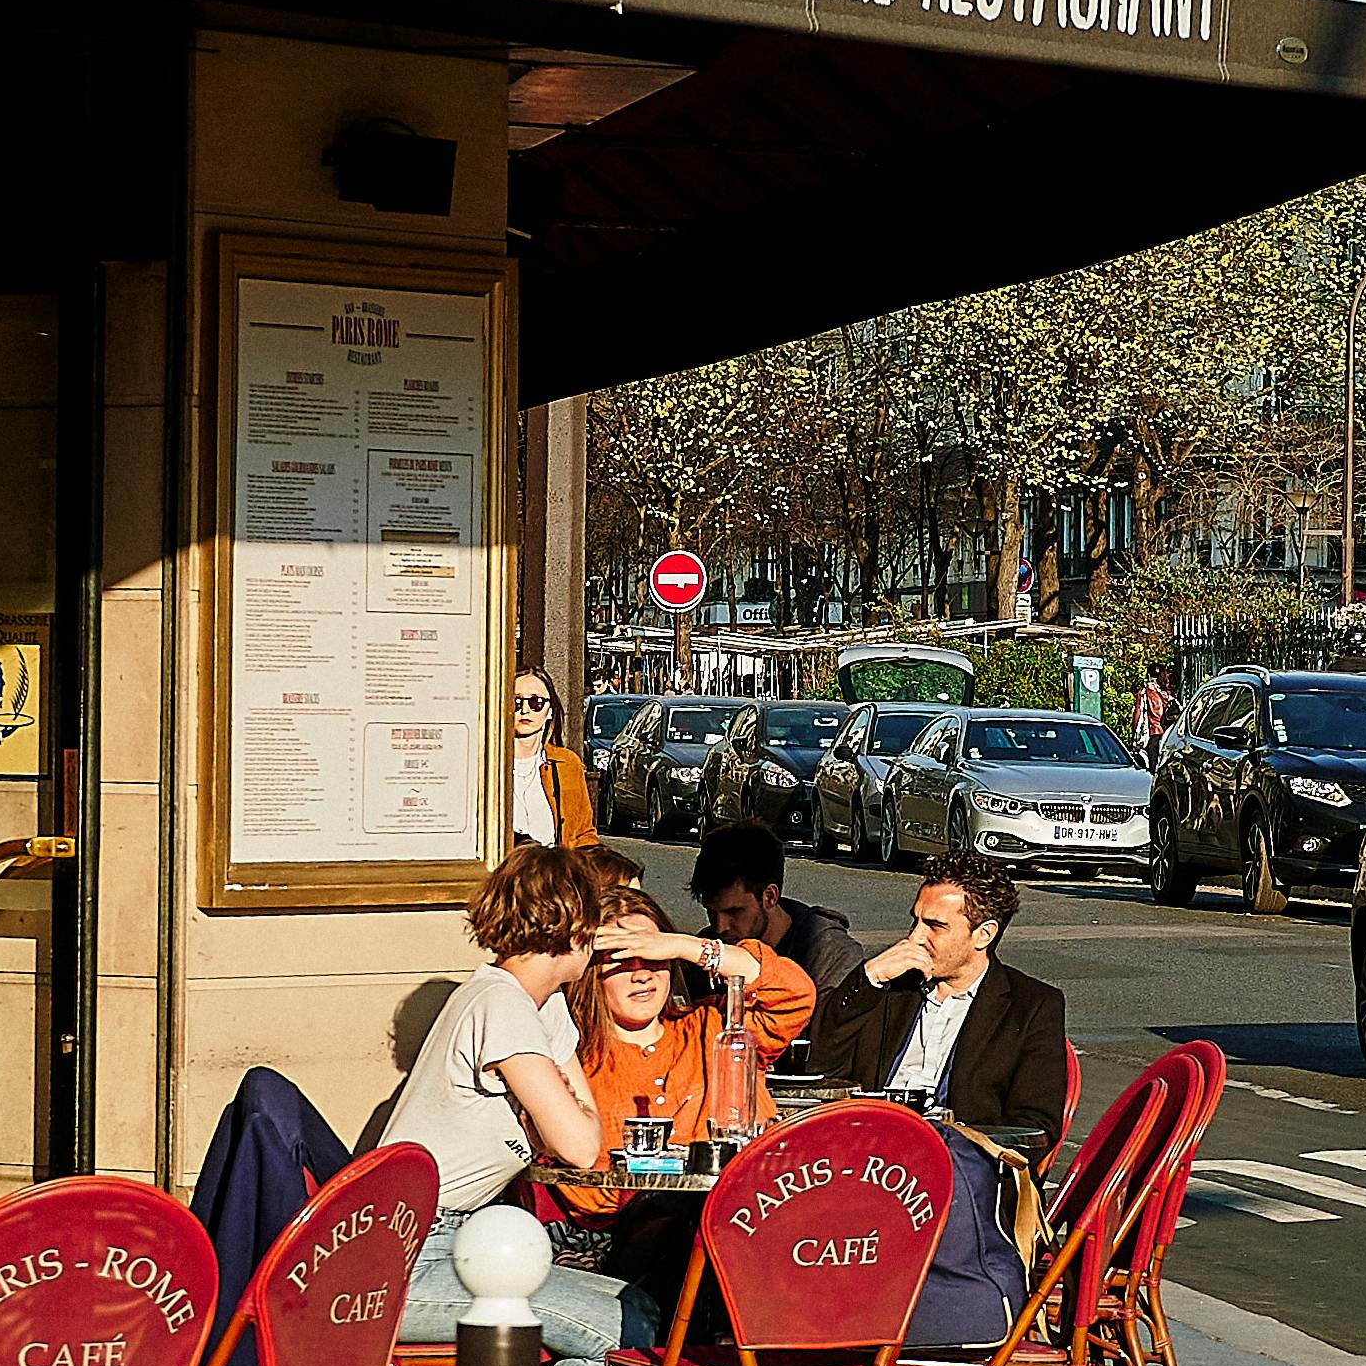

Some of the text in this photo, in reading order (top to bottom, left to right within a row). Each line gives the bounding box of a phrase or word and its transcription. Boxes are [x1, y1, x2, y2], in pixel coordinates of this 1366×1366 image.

[332, 315, 400, 348] PARIS ROME
[742, 607, 770, 621] Offi
[730, 1158, 833, 1237] PARIS
[860, 1155, 934, 1231] ROME
[287, 1204, 375, 1294] PARIS
[792, 1230, 880, 1267] CAFÉ
[98, 1246, 196, 1335] ROME
[329, 1281, 388, 1325] CAFÉ
